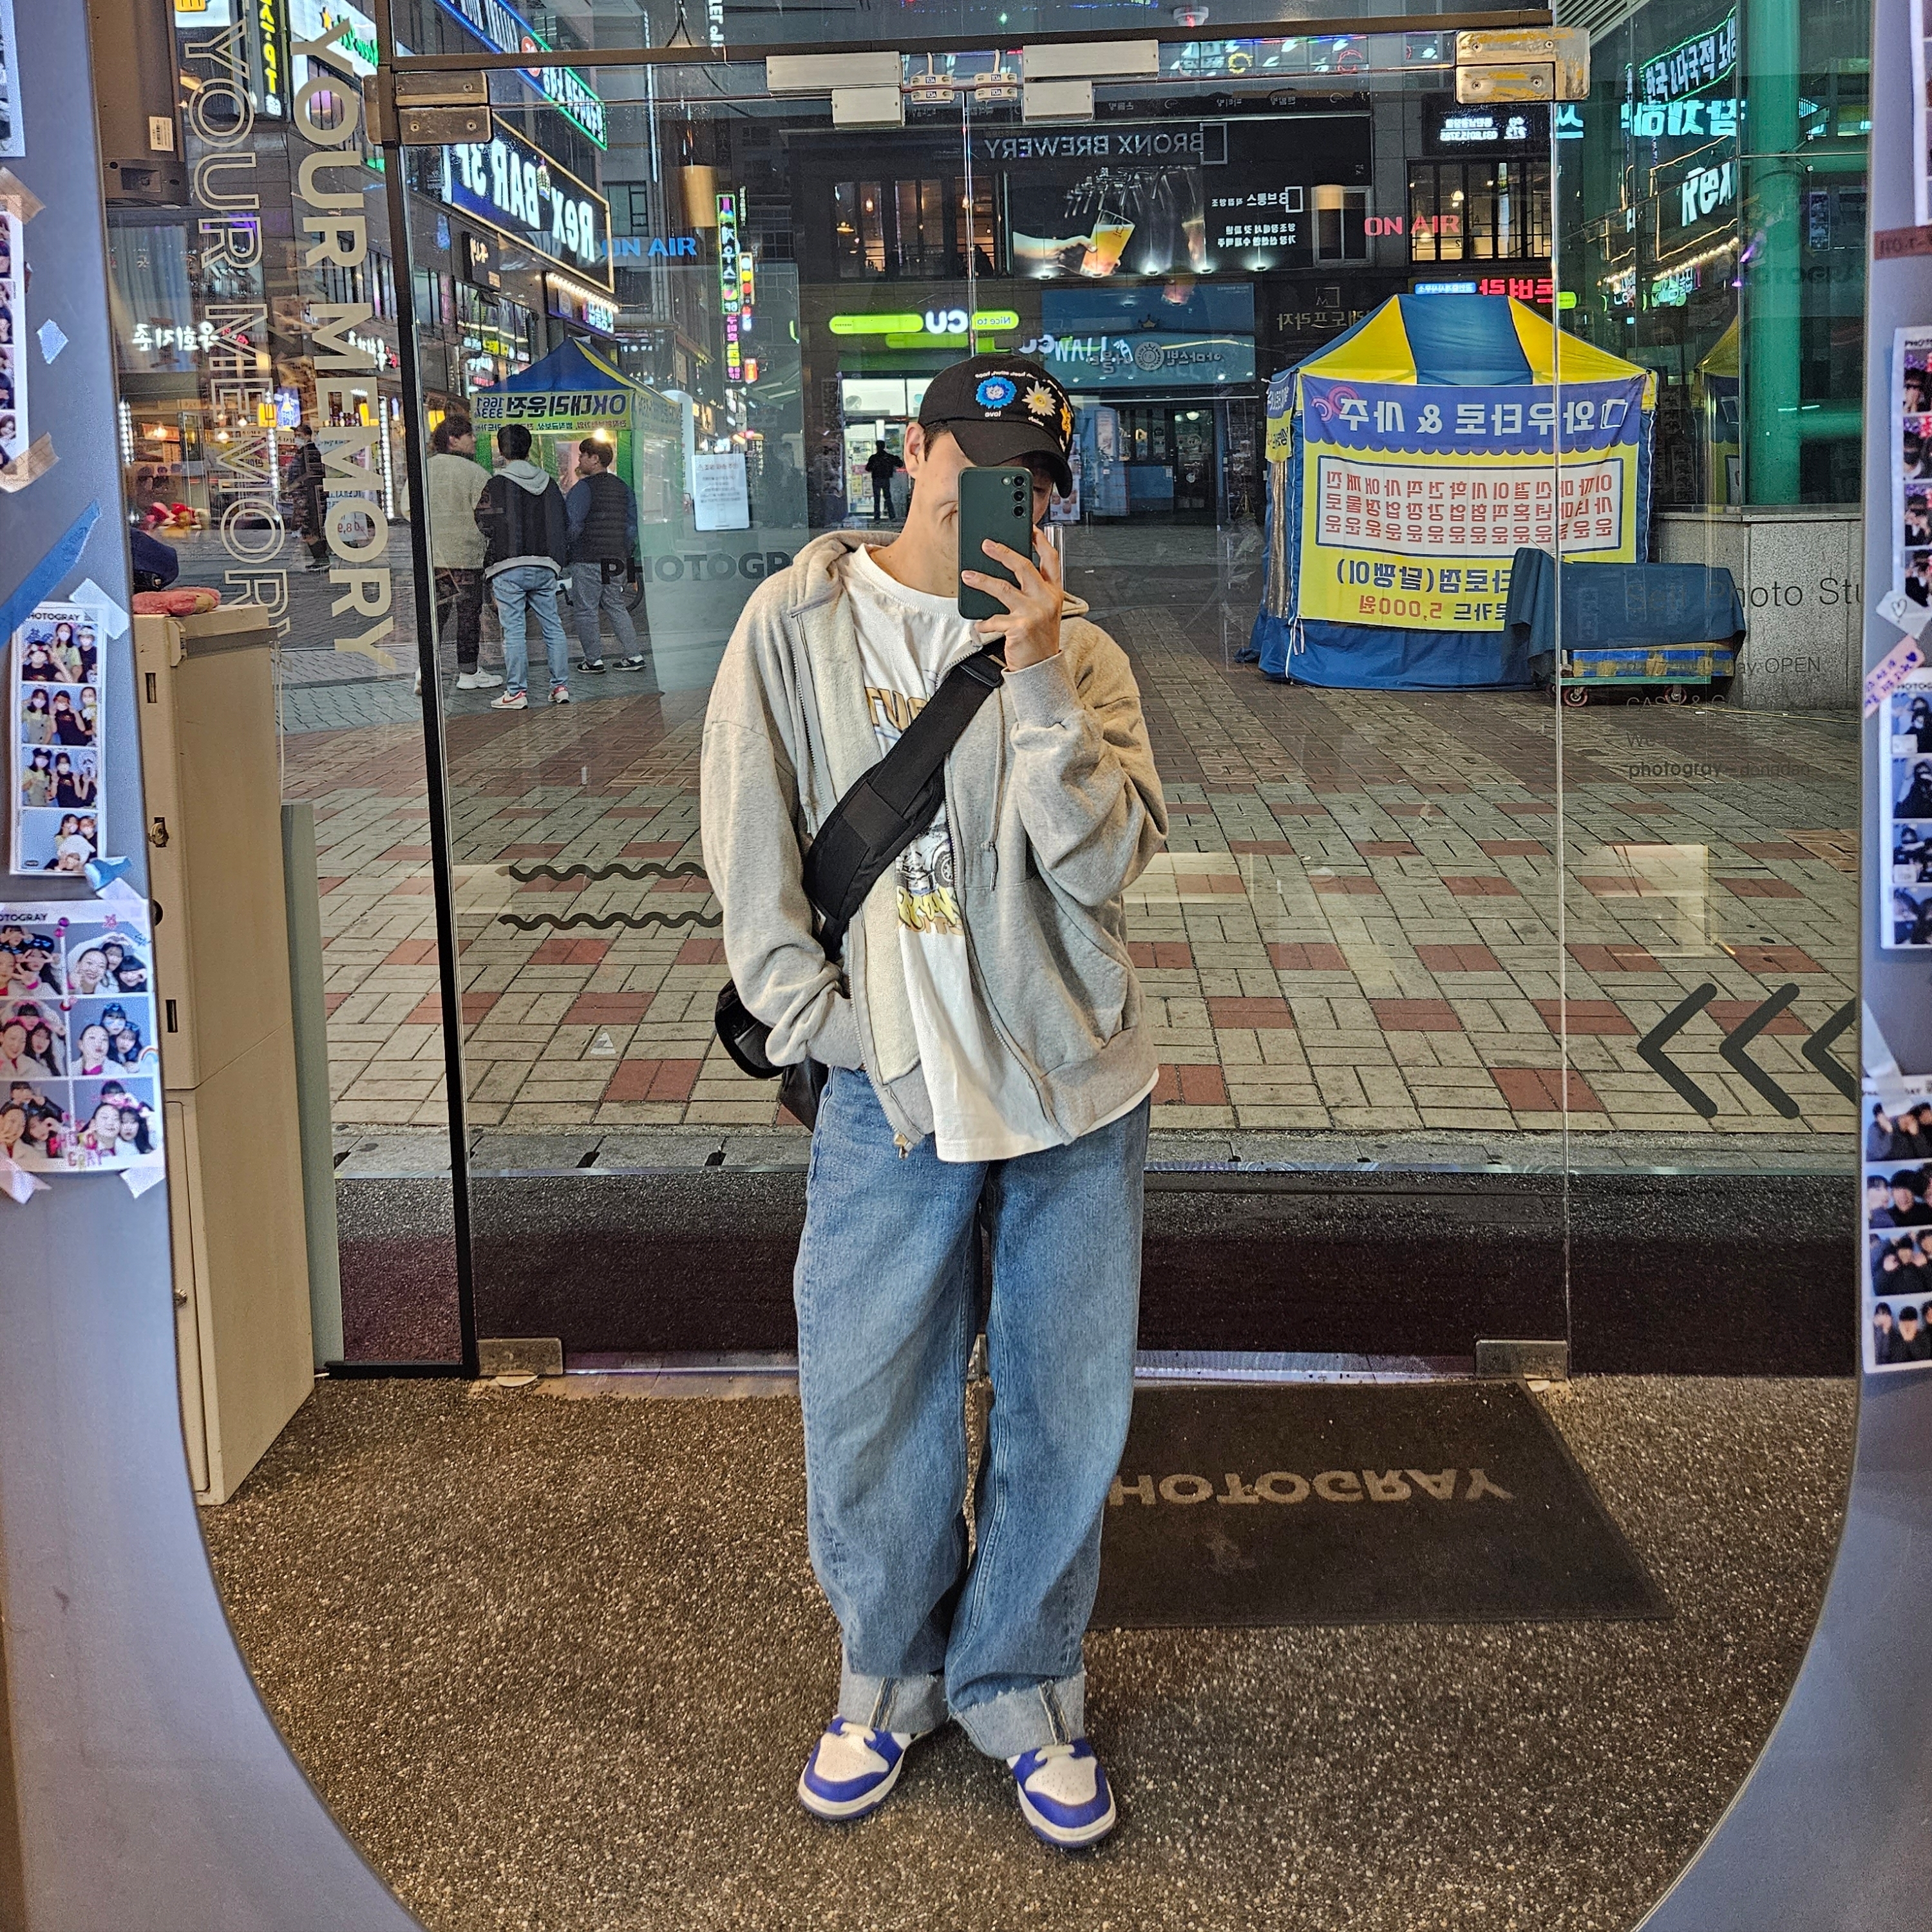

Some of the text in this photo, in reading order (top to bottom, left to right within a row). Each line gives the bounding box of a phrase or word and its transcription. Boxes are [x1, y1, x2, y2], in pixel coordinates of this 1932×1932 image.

[185, 19, 263, 269] YOUR
[289, 17, 367, 268] YOUR
[601, 237, 697, 257] ON AIR
[1364, 215, 1460, 236] ON AIR
[307, 301, 397, 670] MEMORY
[1765, 657, 1821, 674] OPEN
